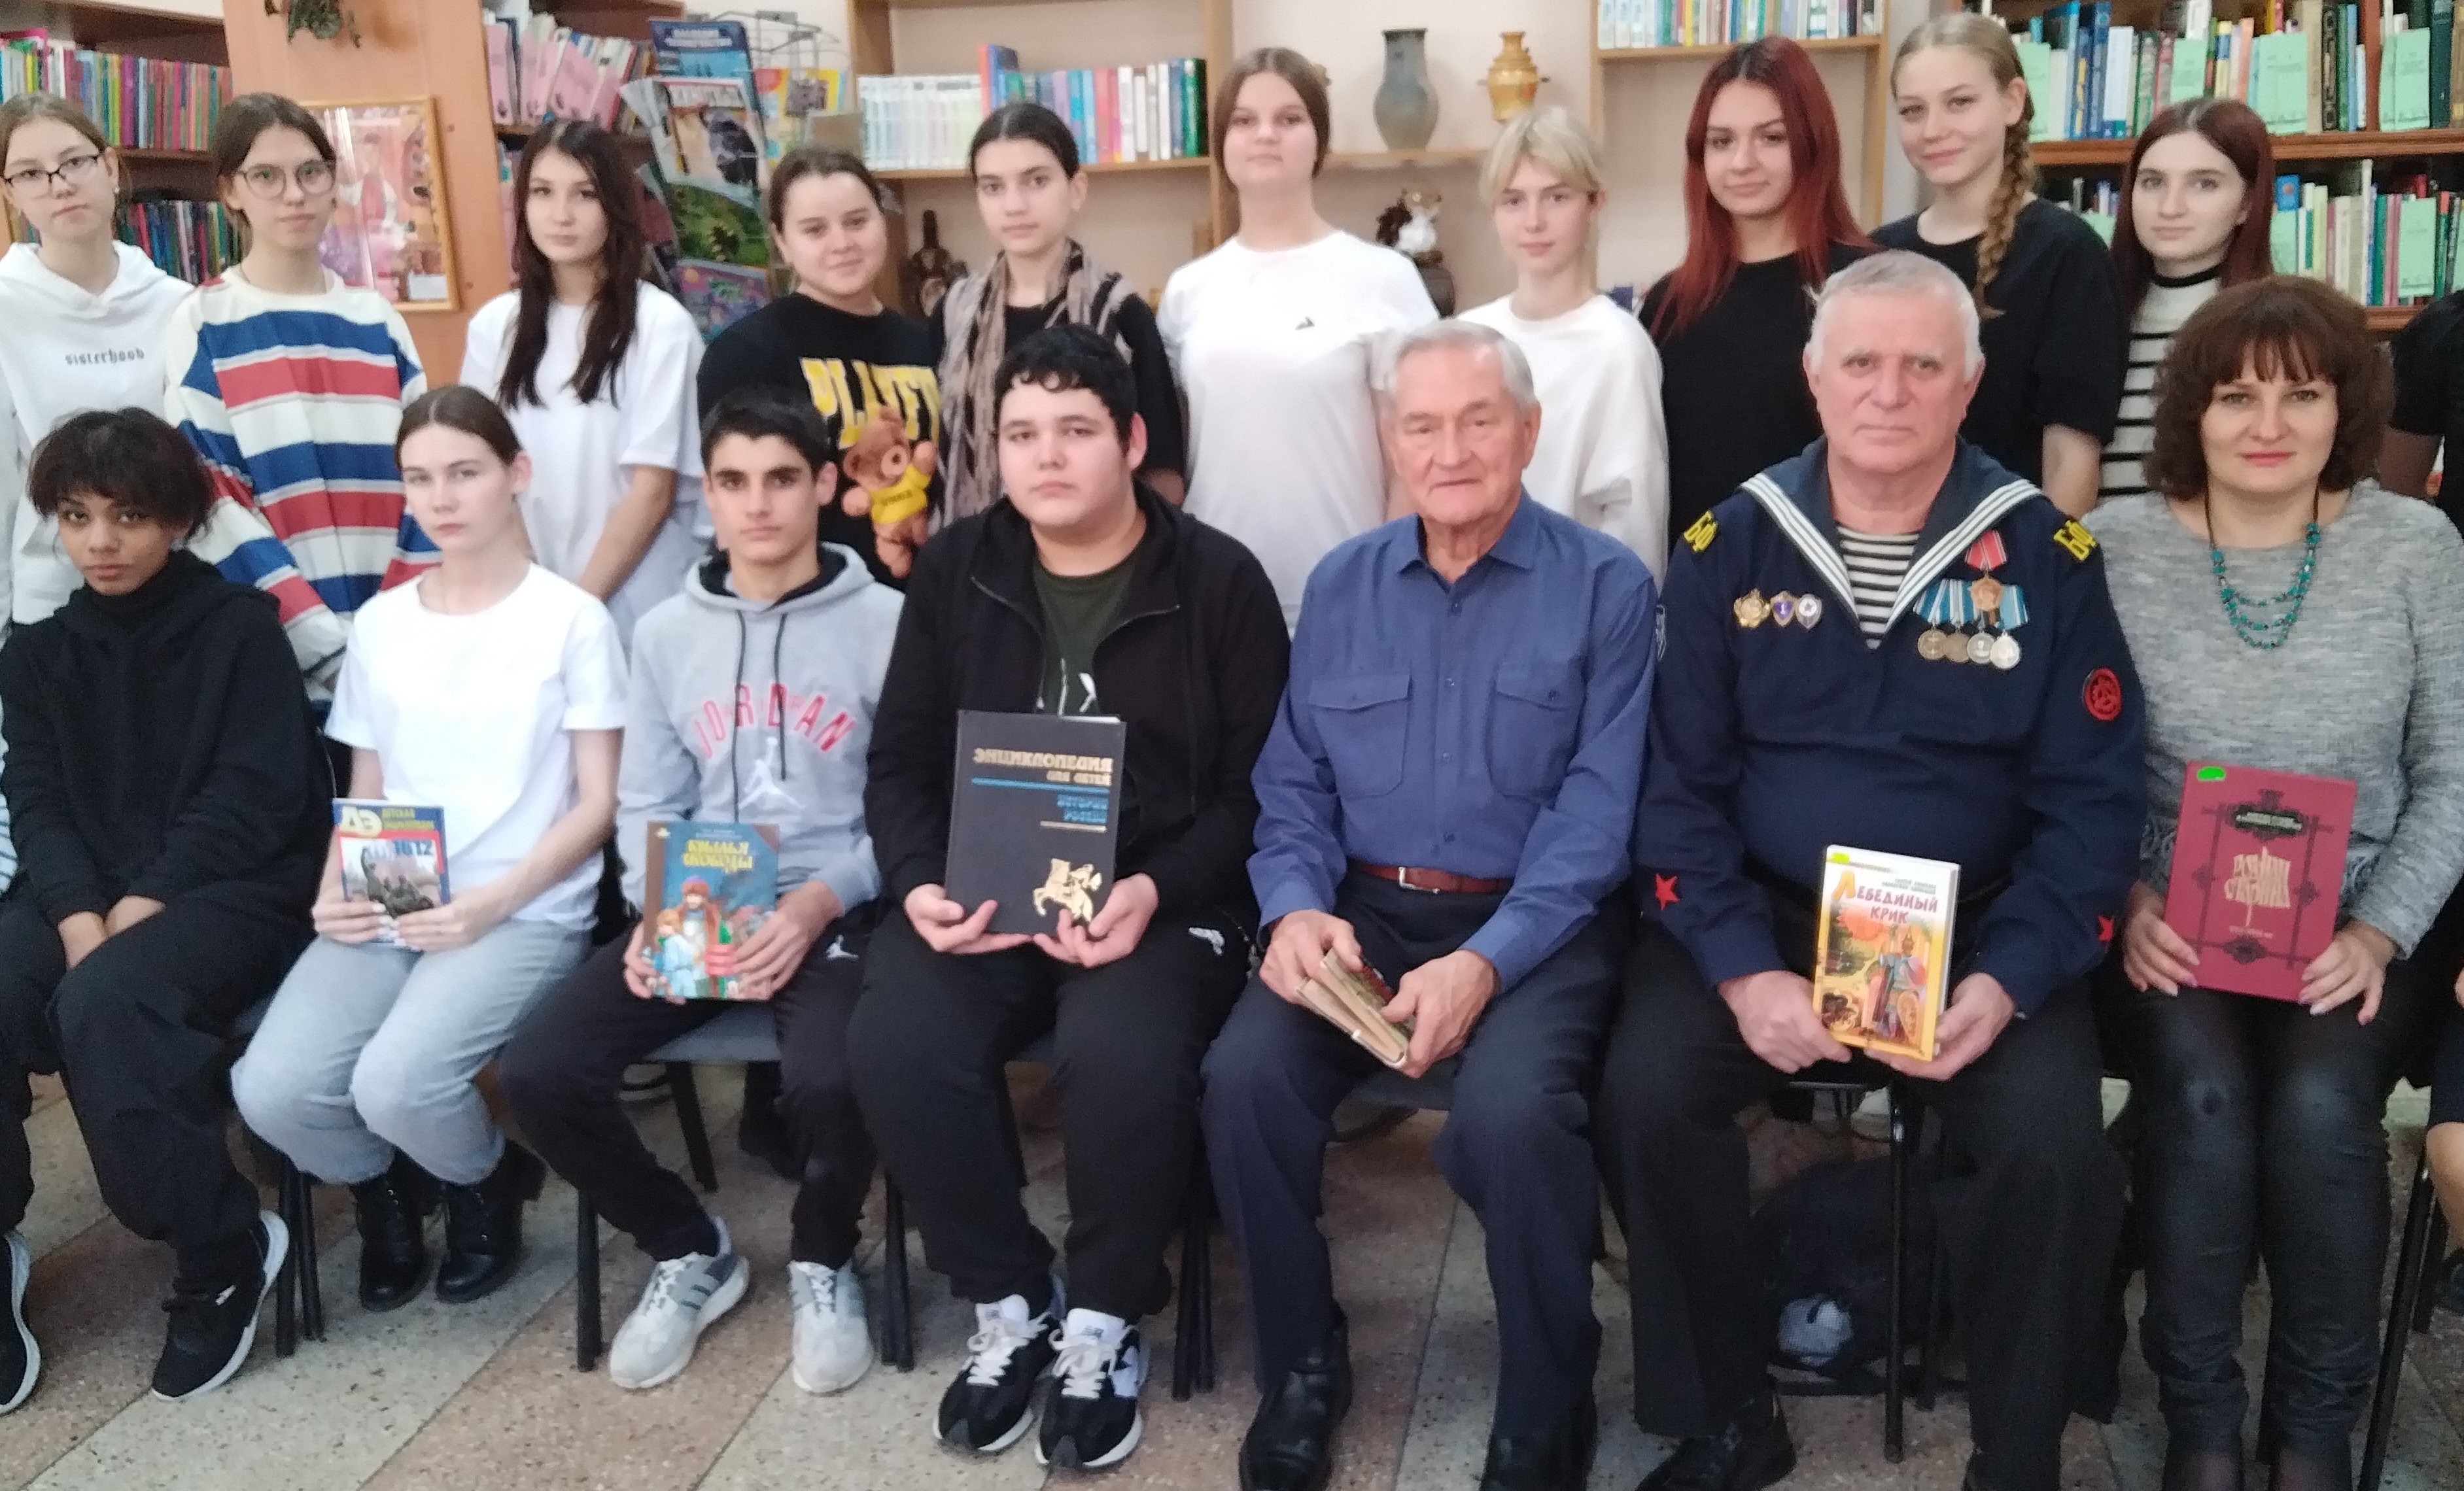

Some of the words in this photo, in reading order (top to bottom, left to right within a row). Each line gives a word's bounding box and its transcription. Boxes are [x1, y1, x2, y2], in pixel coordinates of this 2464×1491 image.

[65, 348, 145, 365] sisterhood
[693, 682, 856, 759] JORDAN
[1831, 870, 1938, 913] ЛЕБЕДИНЫЙ
[1870, 906, 1909, 924] КРИК
